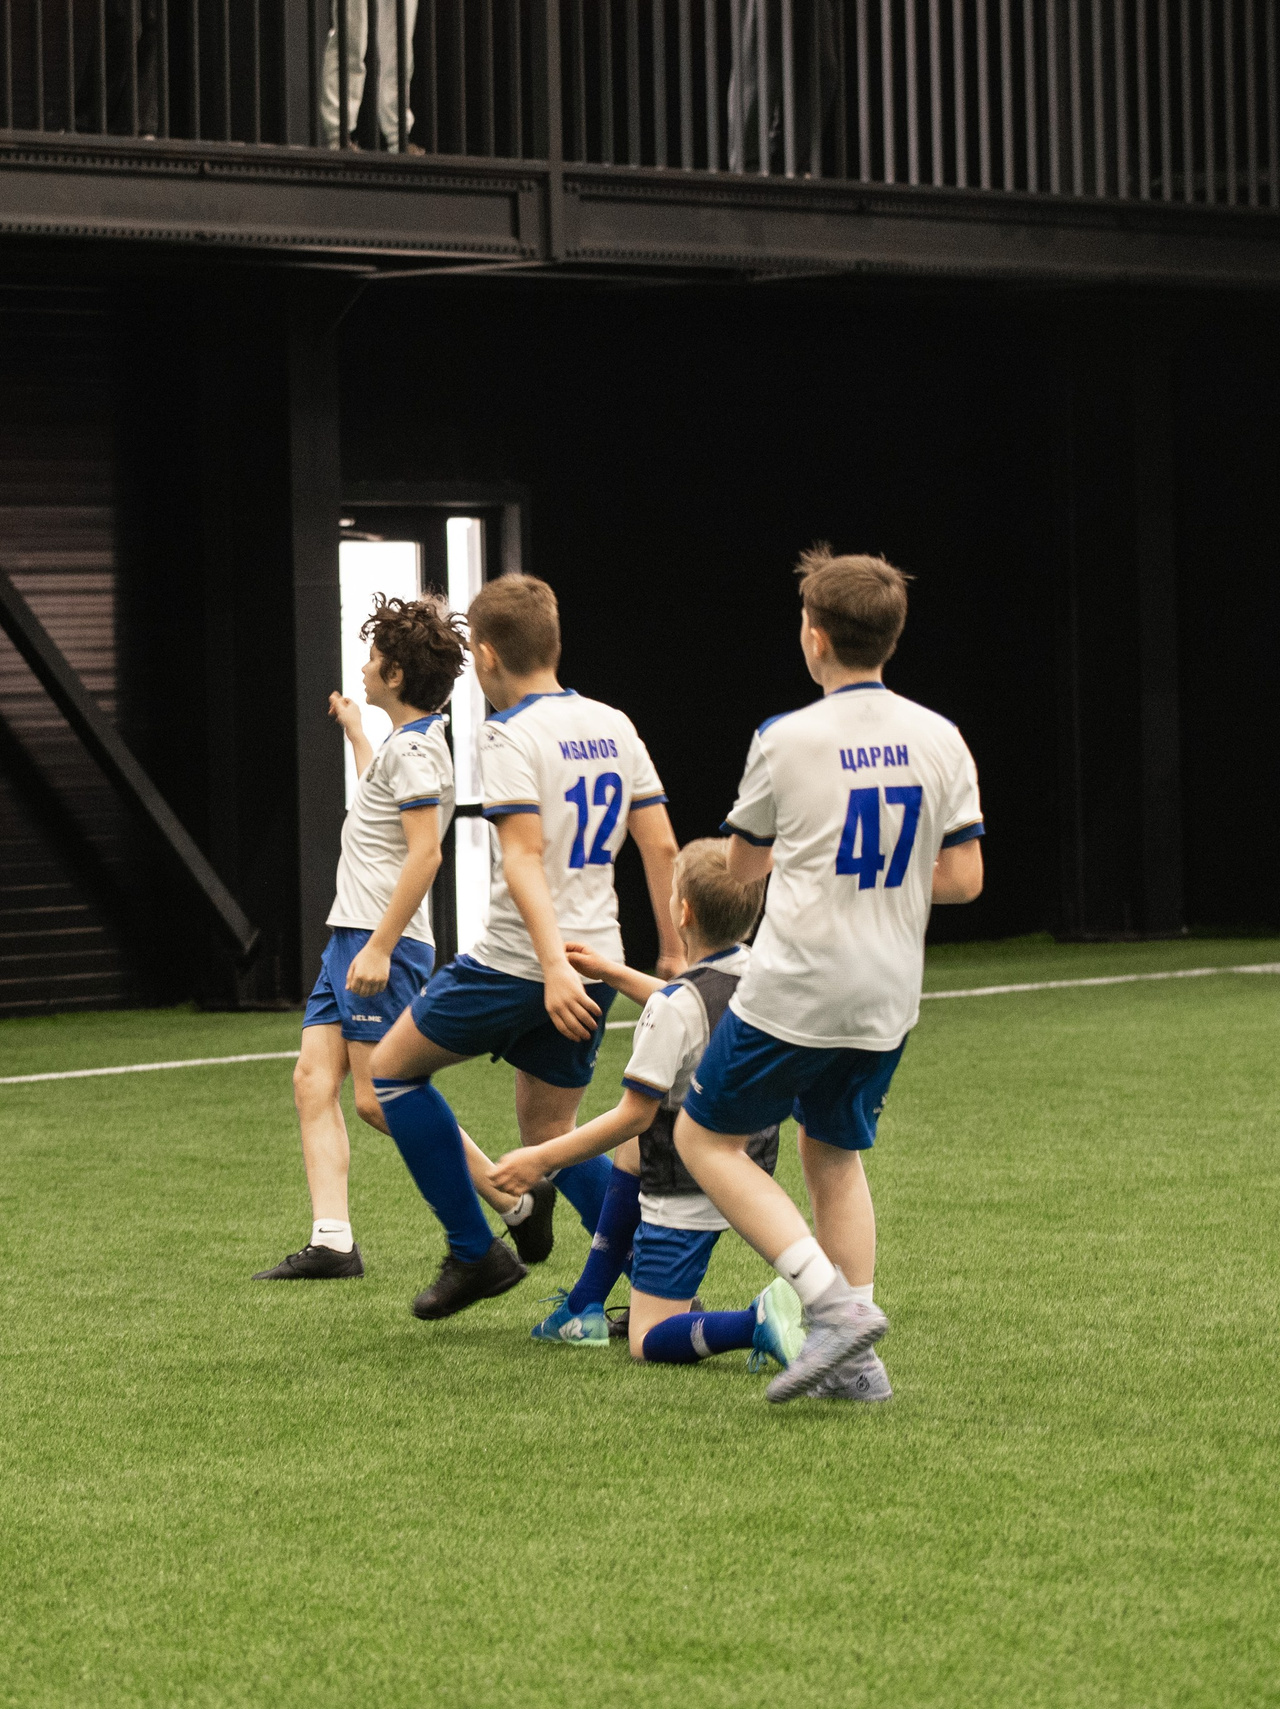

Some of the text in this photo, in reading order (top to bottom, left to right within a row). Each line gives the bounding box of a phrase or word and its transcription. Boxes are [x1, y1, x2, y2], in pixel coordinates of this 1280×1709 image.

[558, 738, 618, 760] ИВАНОВ
[839, 744, 909, 773] ЦАРАН
[564, 772, 623, 869] 12
[836, 786, 923, 889] 47
